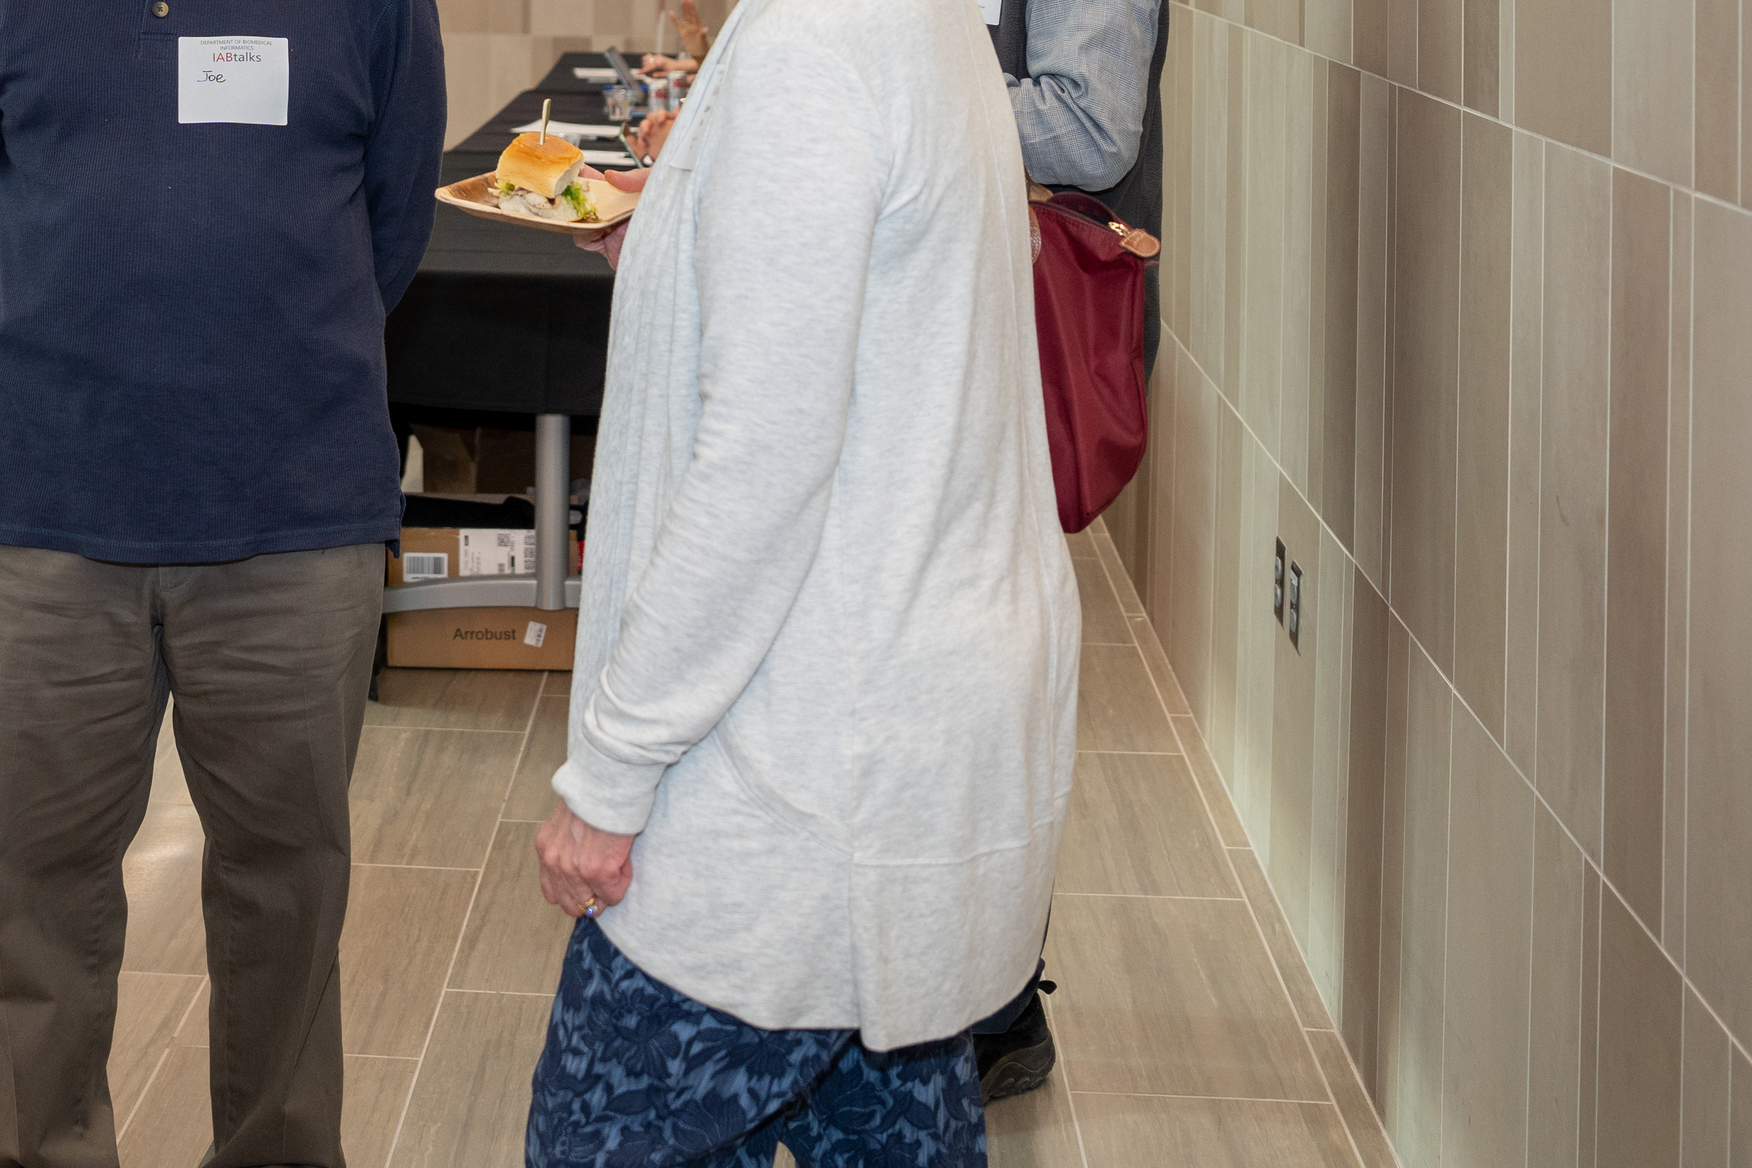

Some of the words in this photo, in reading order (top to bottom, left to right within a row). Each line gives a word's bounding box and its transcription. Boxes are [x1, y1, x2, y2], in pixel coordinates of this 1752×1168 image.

[212, 52, 262, 62] IABtalks
[197, 70, 226, 83] Joe
[453, 628, 517, 641] Arrobust
